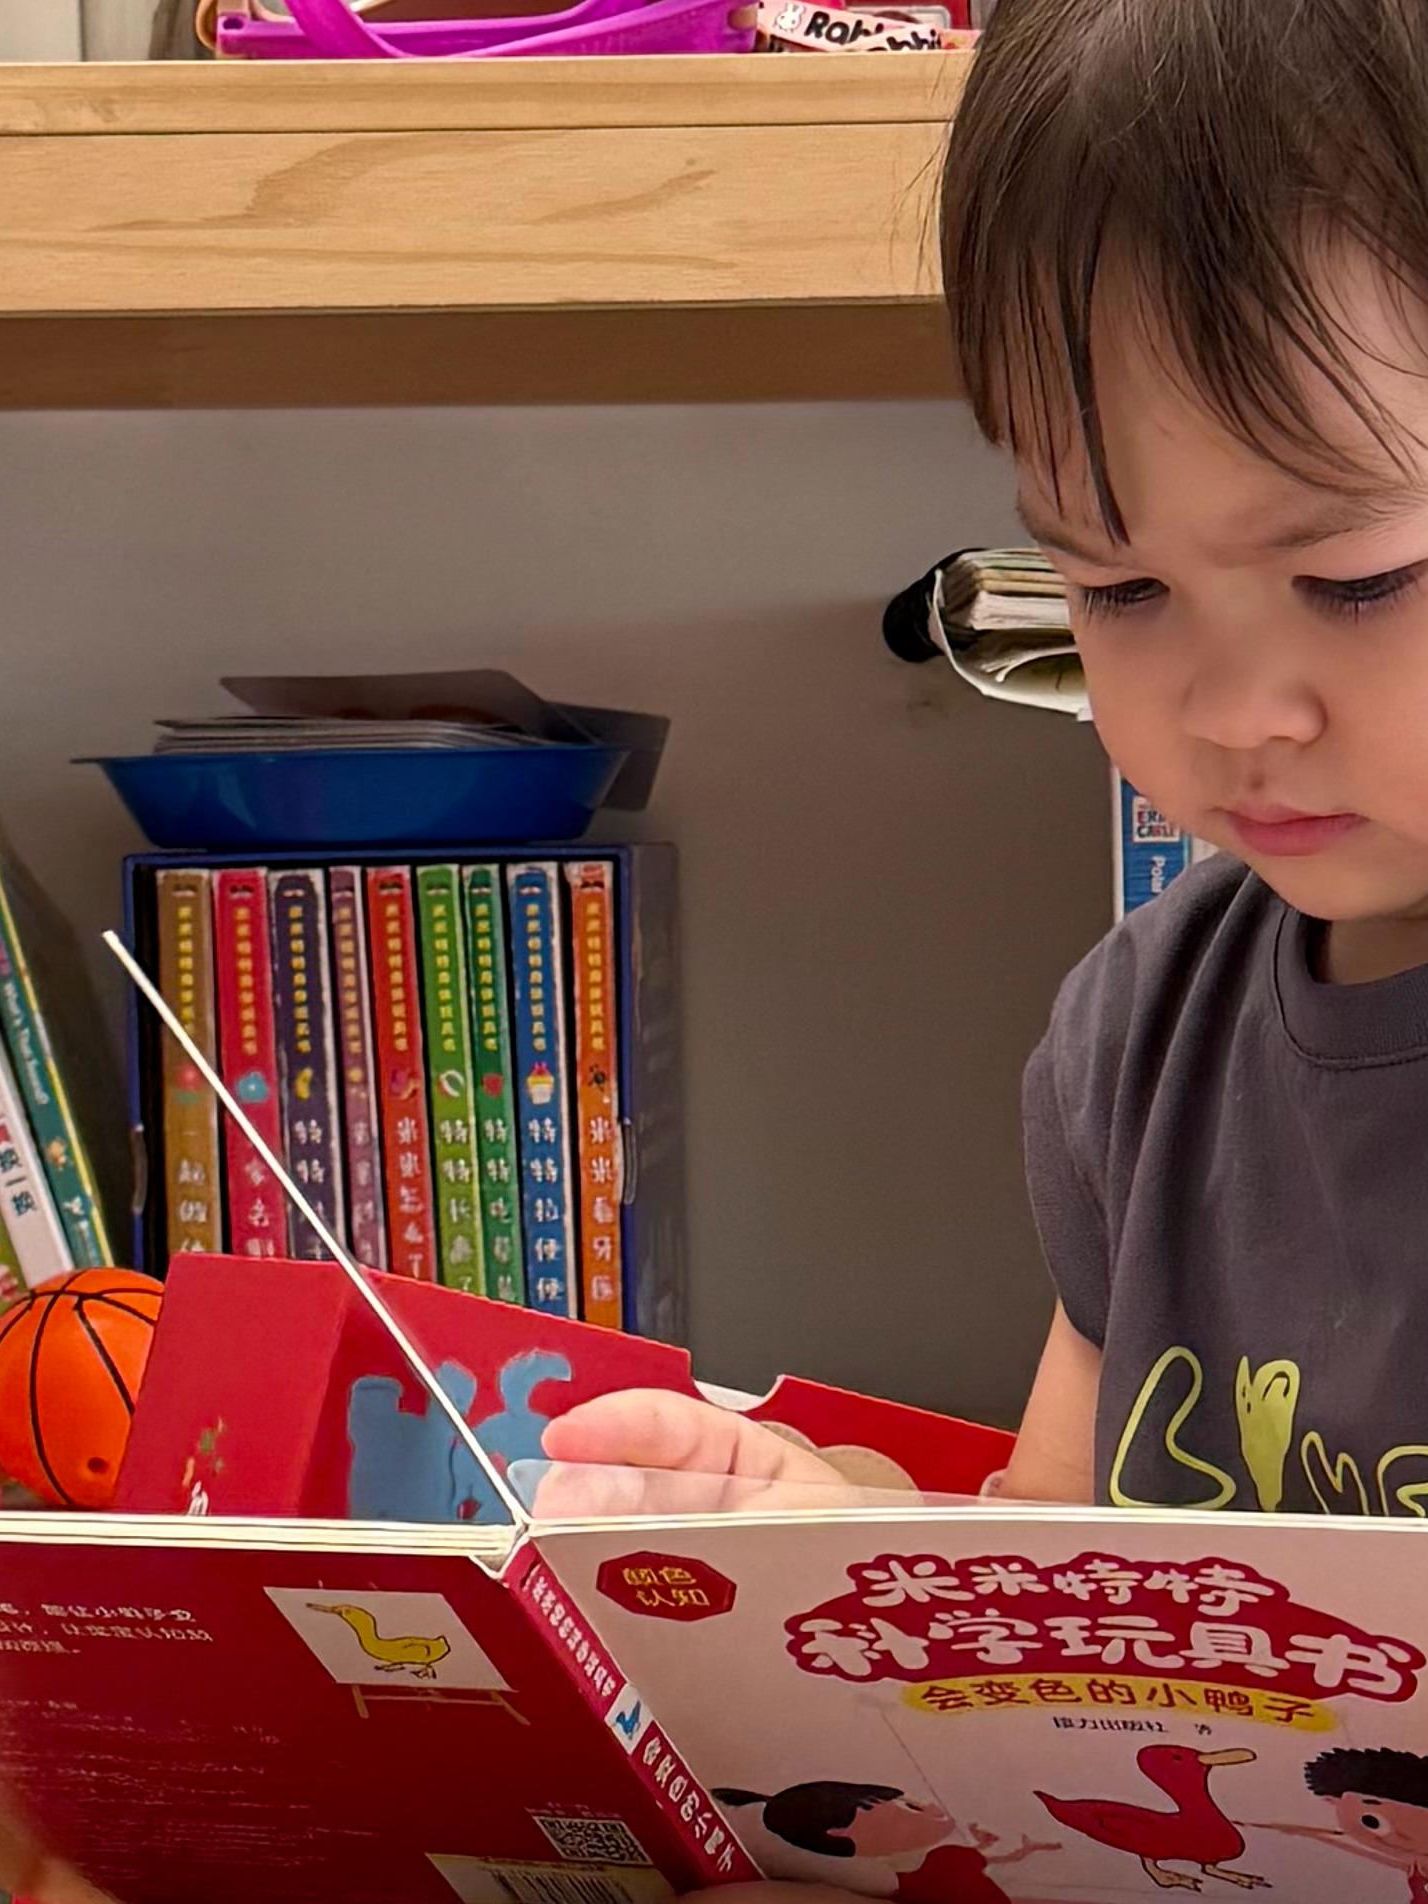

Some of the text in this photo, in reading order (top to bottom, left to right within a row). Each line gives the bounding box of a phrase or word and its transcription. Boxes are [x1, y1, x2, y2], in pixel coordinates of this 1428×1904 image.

[528, 1116, 558, 1303] 特特拉便便
[623, 1565, 697, 1590] 颜色
[637, 1588, 711, 1610] 认知
[862, 1561, 1277, 1617] 米米特特
[798, 1610, 1418, 1695] 科学玩具书
[921, 1678, 1321, 1725] 会变色的小鸭子
[641, 1735, 740, 1876] 会变色的小鸭子
